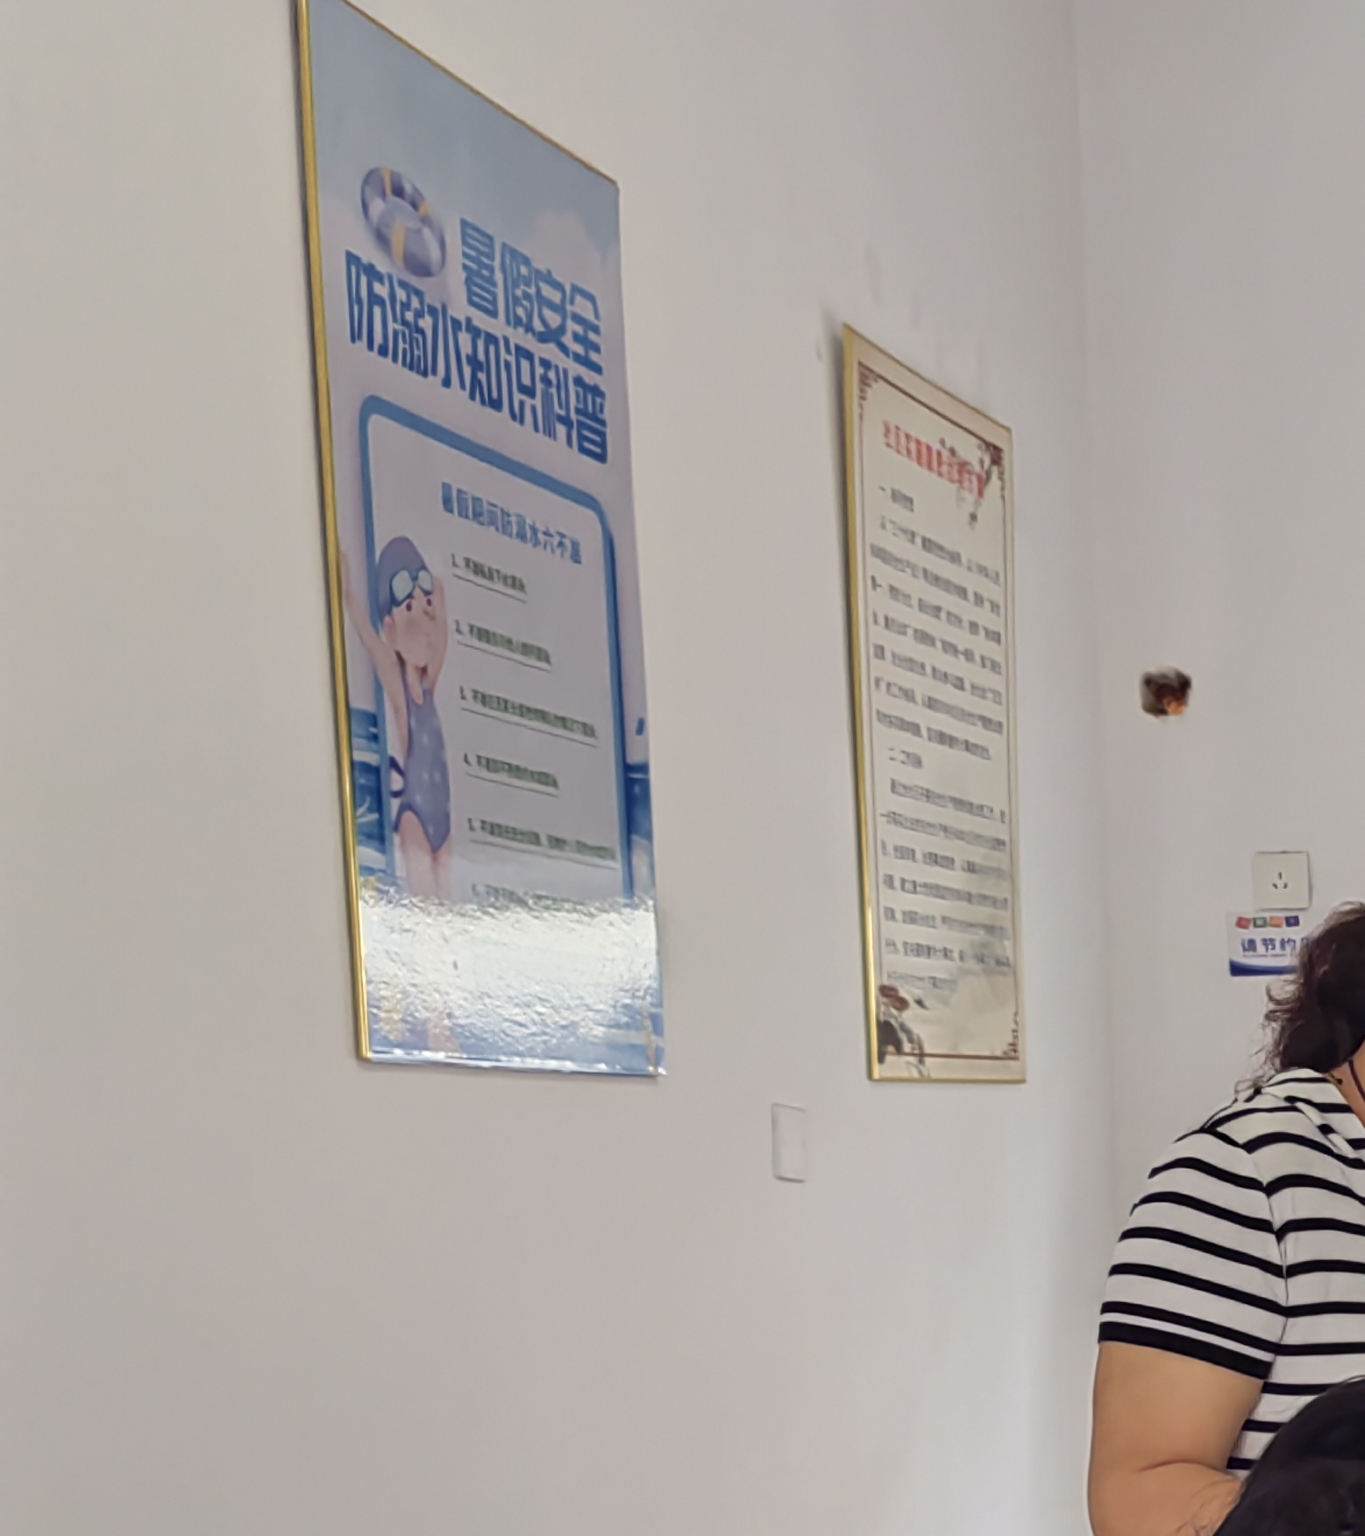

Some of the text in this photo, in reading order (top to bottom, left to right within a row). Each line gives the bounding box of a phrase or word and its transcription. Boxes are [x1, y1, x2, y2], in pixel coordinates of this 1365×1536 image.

[345, 249, 608, 465] 防溺水知识科普
[459, 217, 604, 377] 暑假安全
